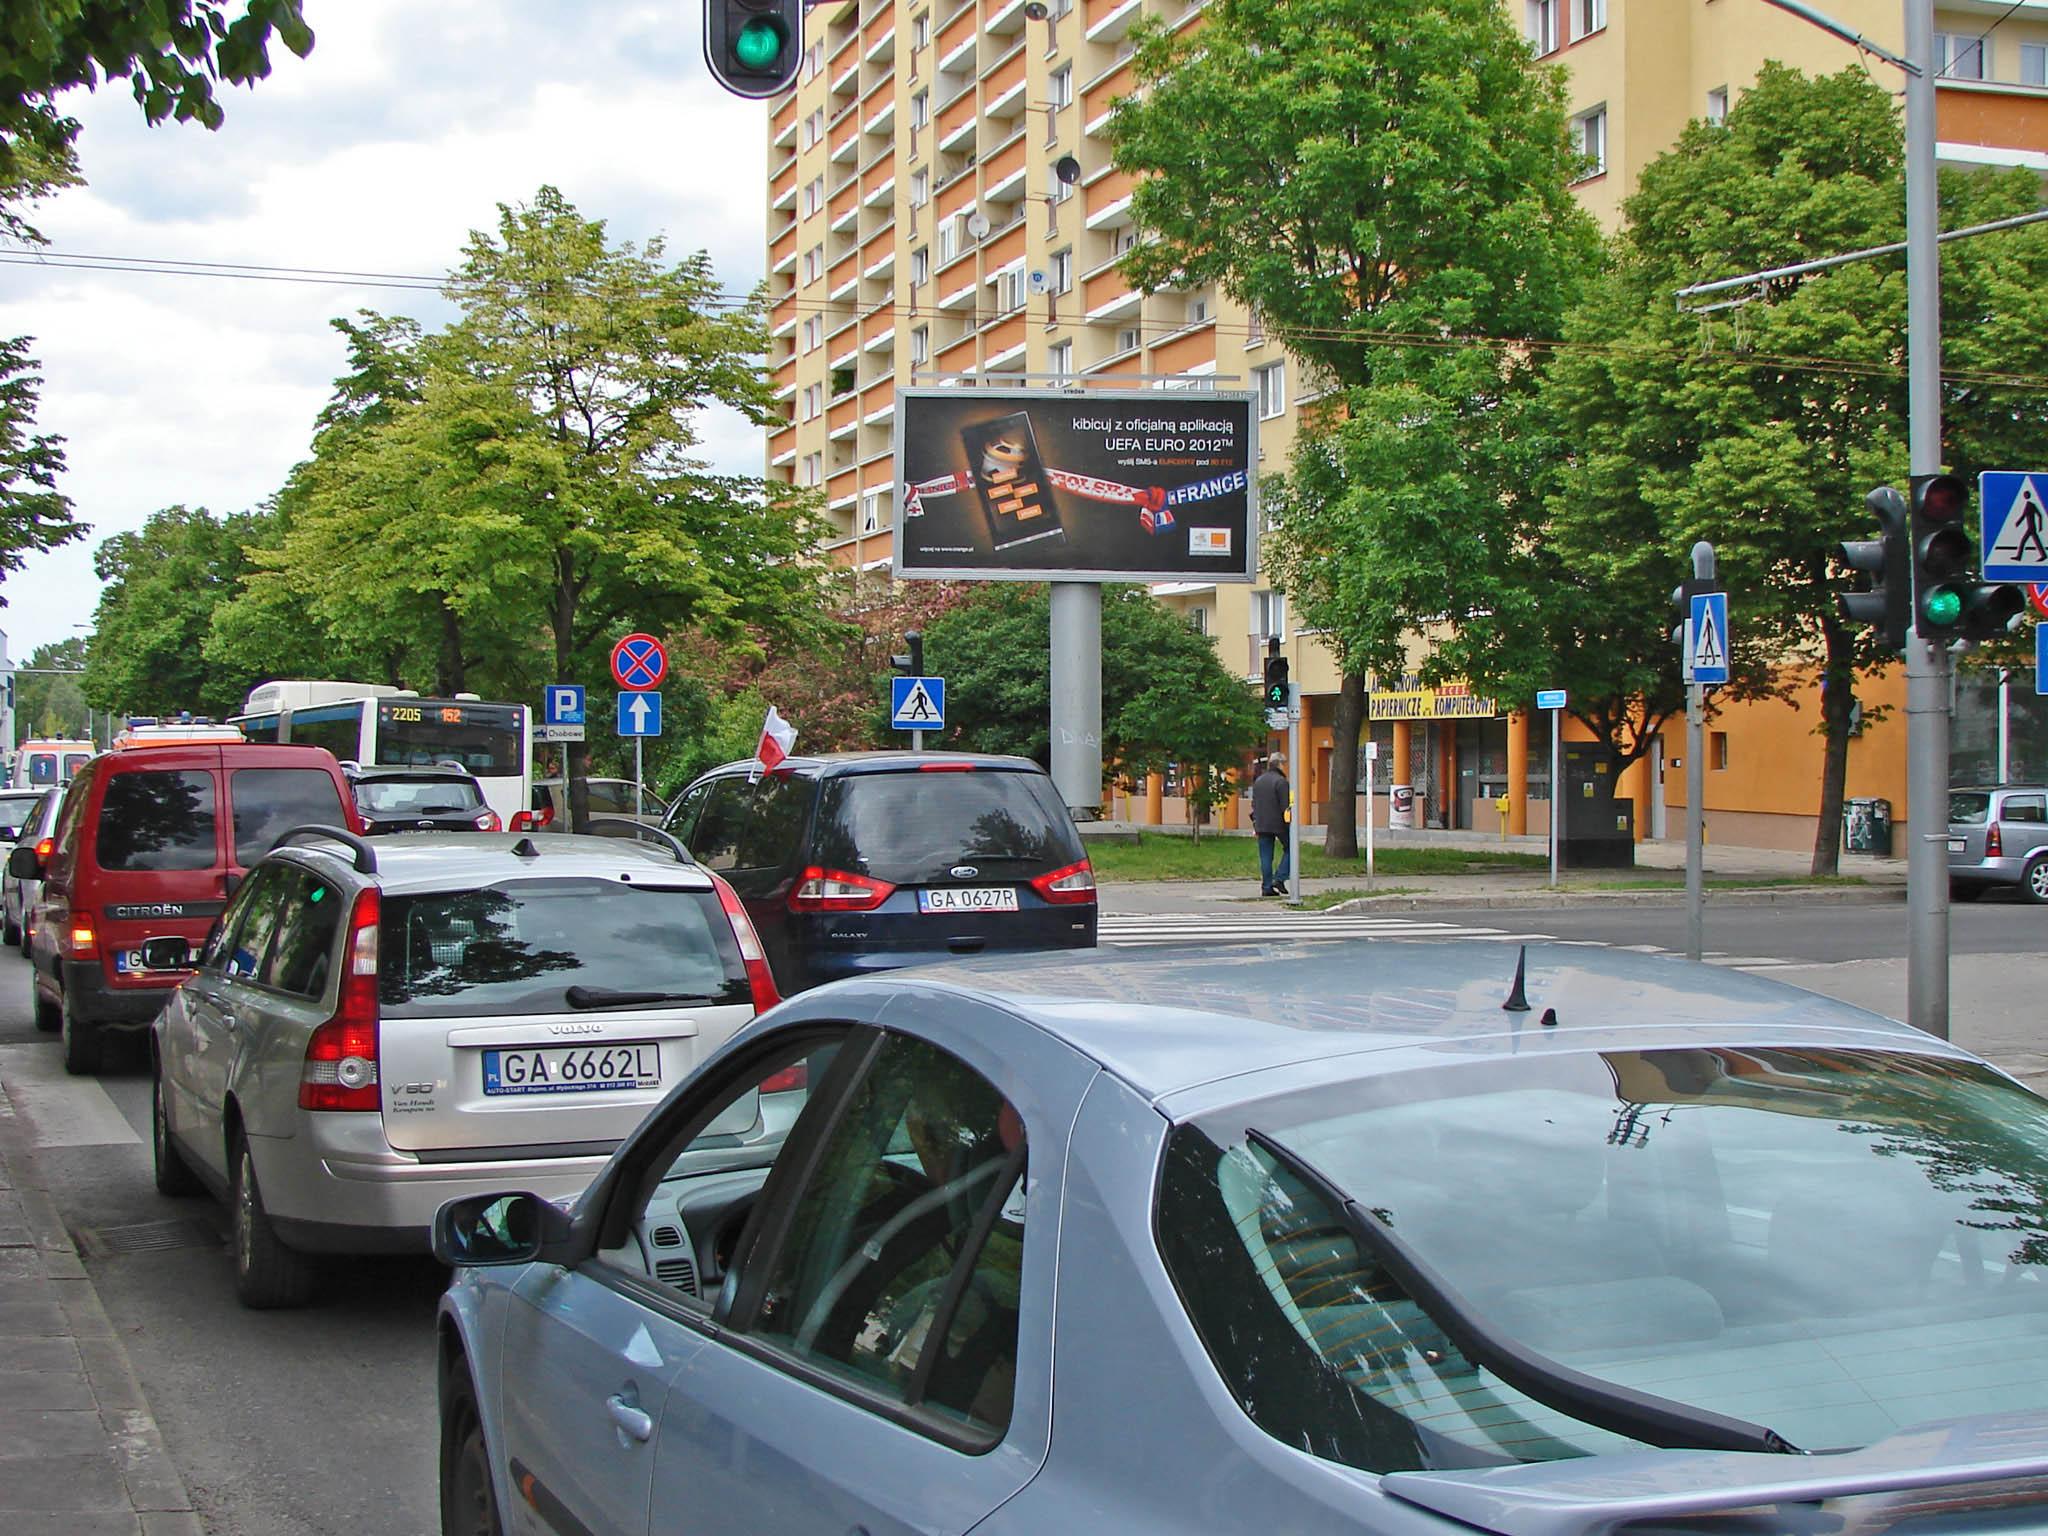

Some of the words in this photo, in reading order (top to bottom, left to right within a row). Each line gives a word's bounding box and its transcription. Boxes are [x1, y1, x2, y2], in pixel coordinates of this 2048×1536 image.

[1072, 418, 1112, 433] kibicuj
[1115, 421, 1123, 430] z
[1126, 418, 1176, 433] oficjalną
[1180, 419, 1234, 434] aplikacją
[1105, 438, 1142, 451] UEFA
[1145, 439, 1185, 451] EURO
[1196, 458, 1210, 467] pod
[1053, 473, 1136, 501] POLSKA
[1177, 471, 1245, 504] FRANCE
[556, 690, 577, 720] P
[1371, 697, 1422, 717] PAPIERNICZE
[1434, 696, 1495, 716] KOMPUTEROWE
[392, 708, 421, 722] 2205
[440, 707, 462, 723] 152
[931, 892, 956, 908] GA
[961, 890, 1014, 907] 0627R
[116, 903, 183, 917] CITROËN
[548, 1023, 603, 1035] VOLVO
[505, 1053, 550, 1083] GA
[561, 1048, 654, 1081] 6662L
[488, 1073, 499, 1082] PL
[486, 1086, 526, 1094] AUTO-START
